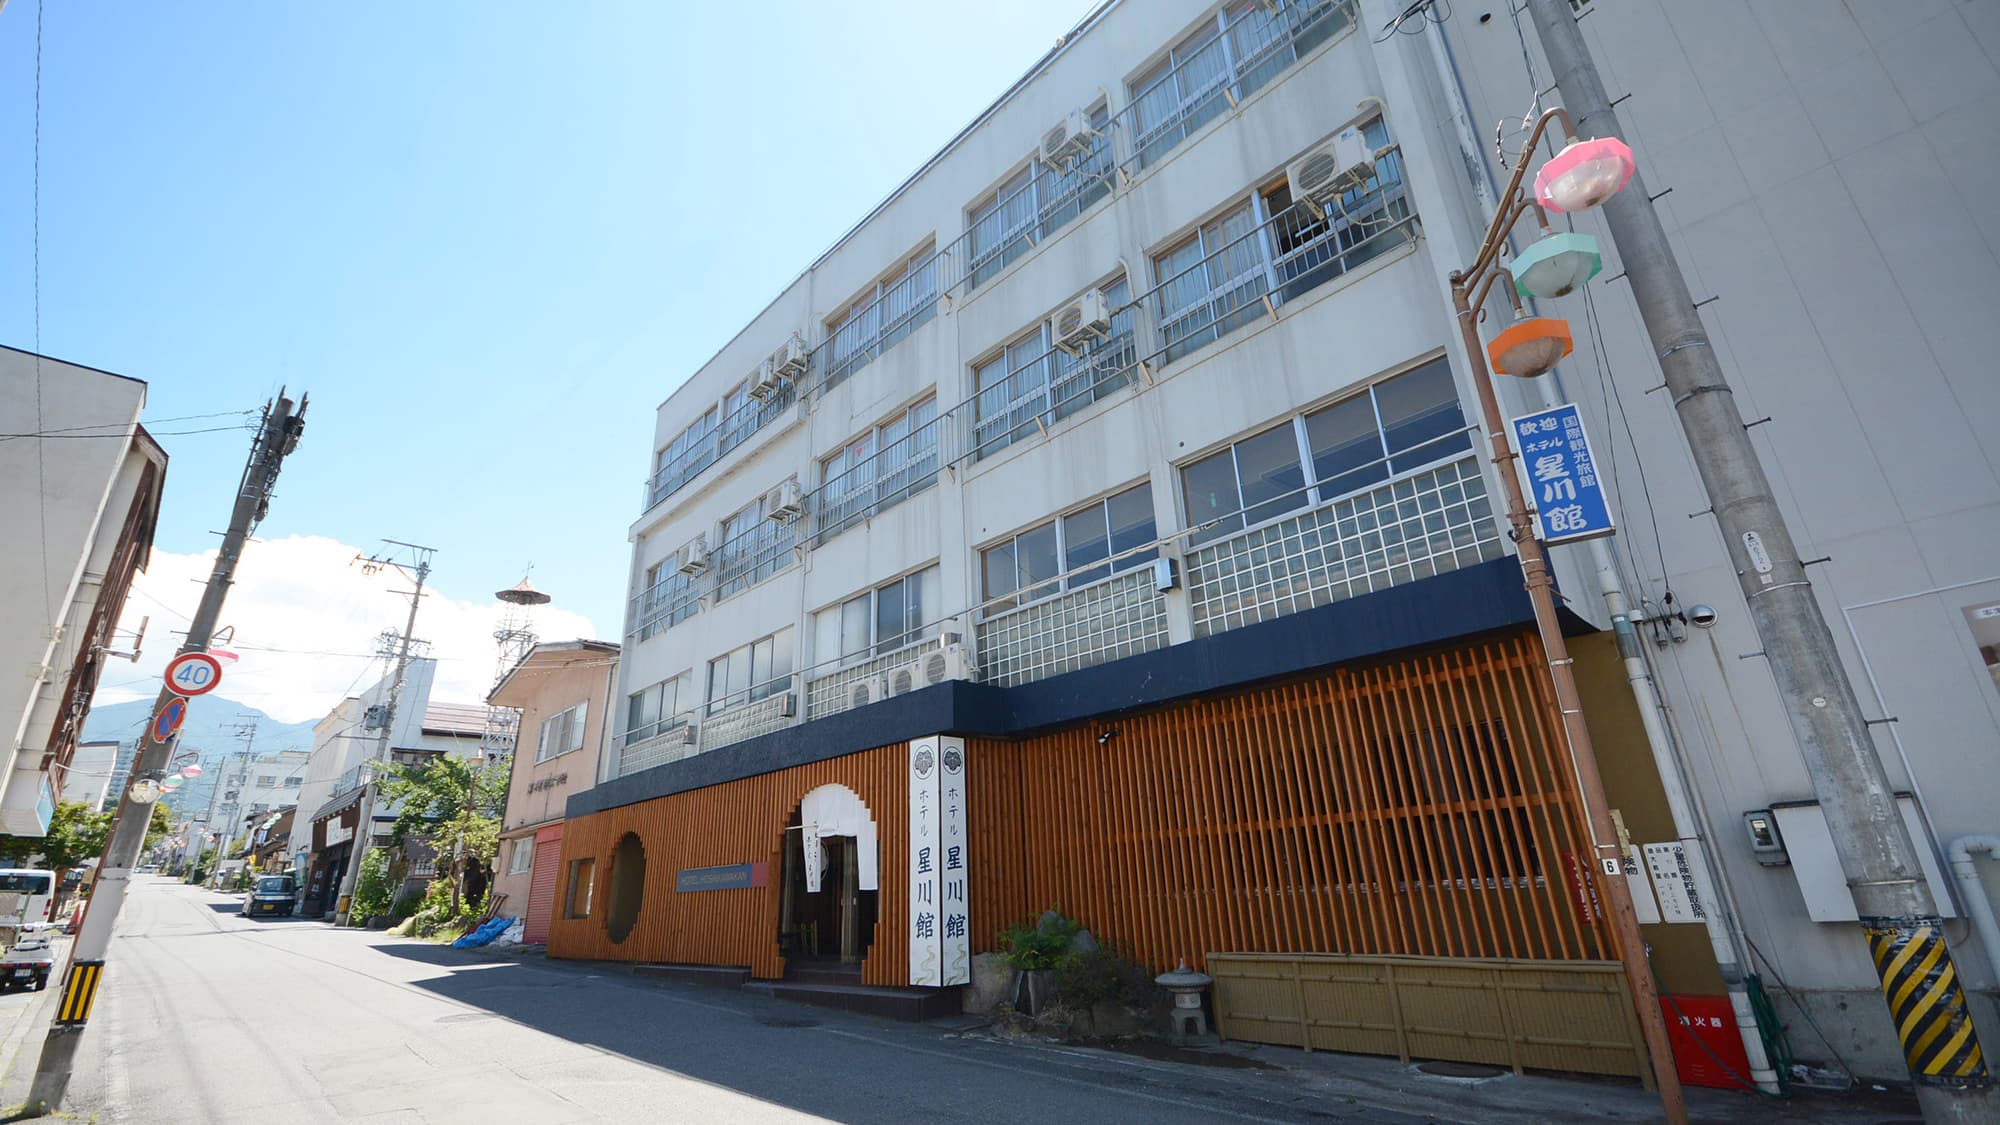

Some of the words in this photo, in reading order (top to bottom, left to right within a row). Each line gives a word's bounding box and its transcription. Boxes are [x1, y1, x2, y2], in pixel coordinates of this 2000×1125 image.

[1519, 417, 1559, 436] 歓迎
[1526, 436, 1564, 453] ホテル
[1563, 415, 1596, 489] 国際観光旅館
[1534, 452, 1588, 532] 星川館
[176, 664, 210, 685] 40
[1606, 861, 1615, 873] 6
